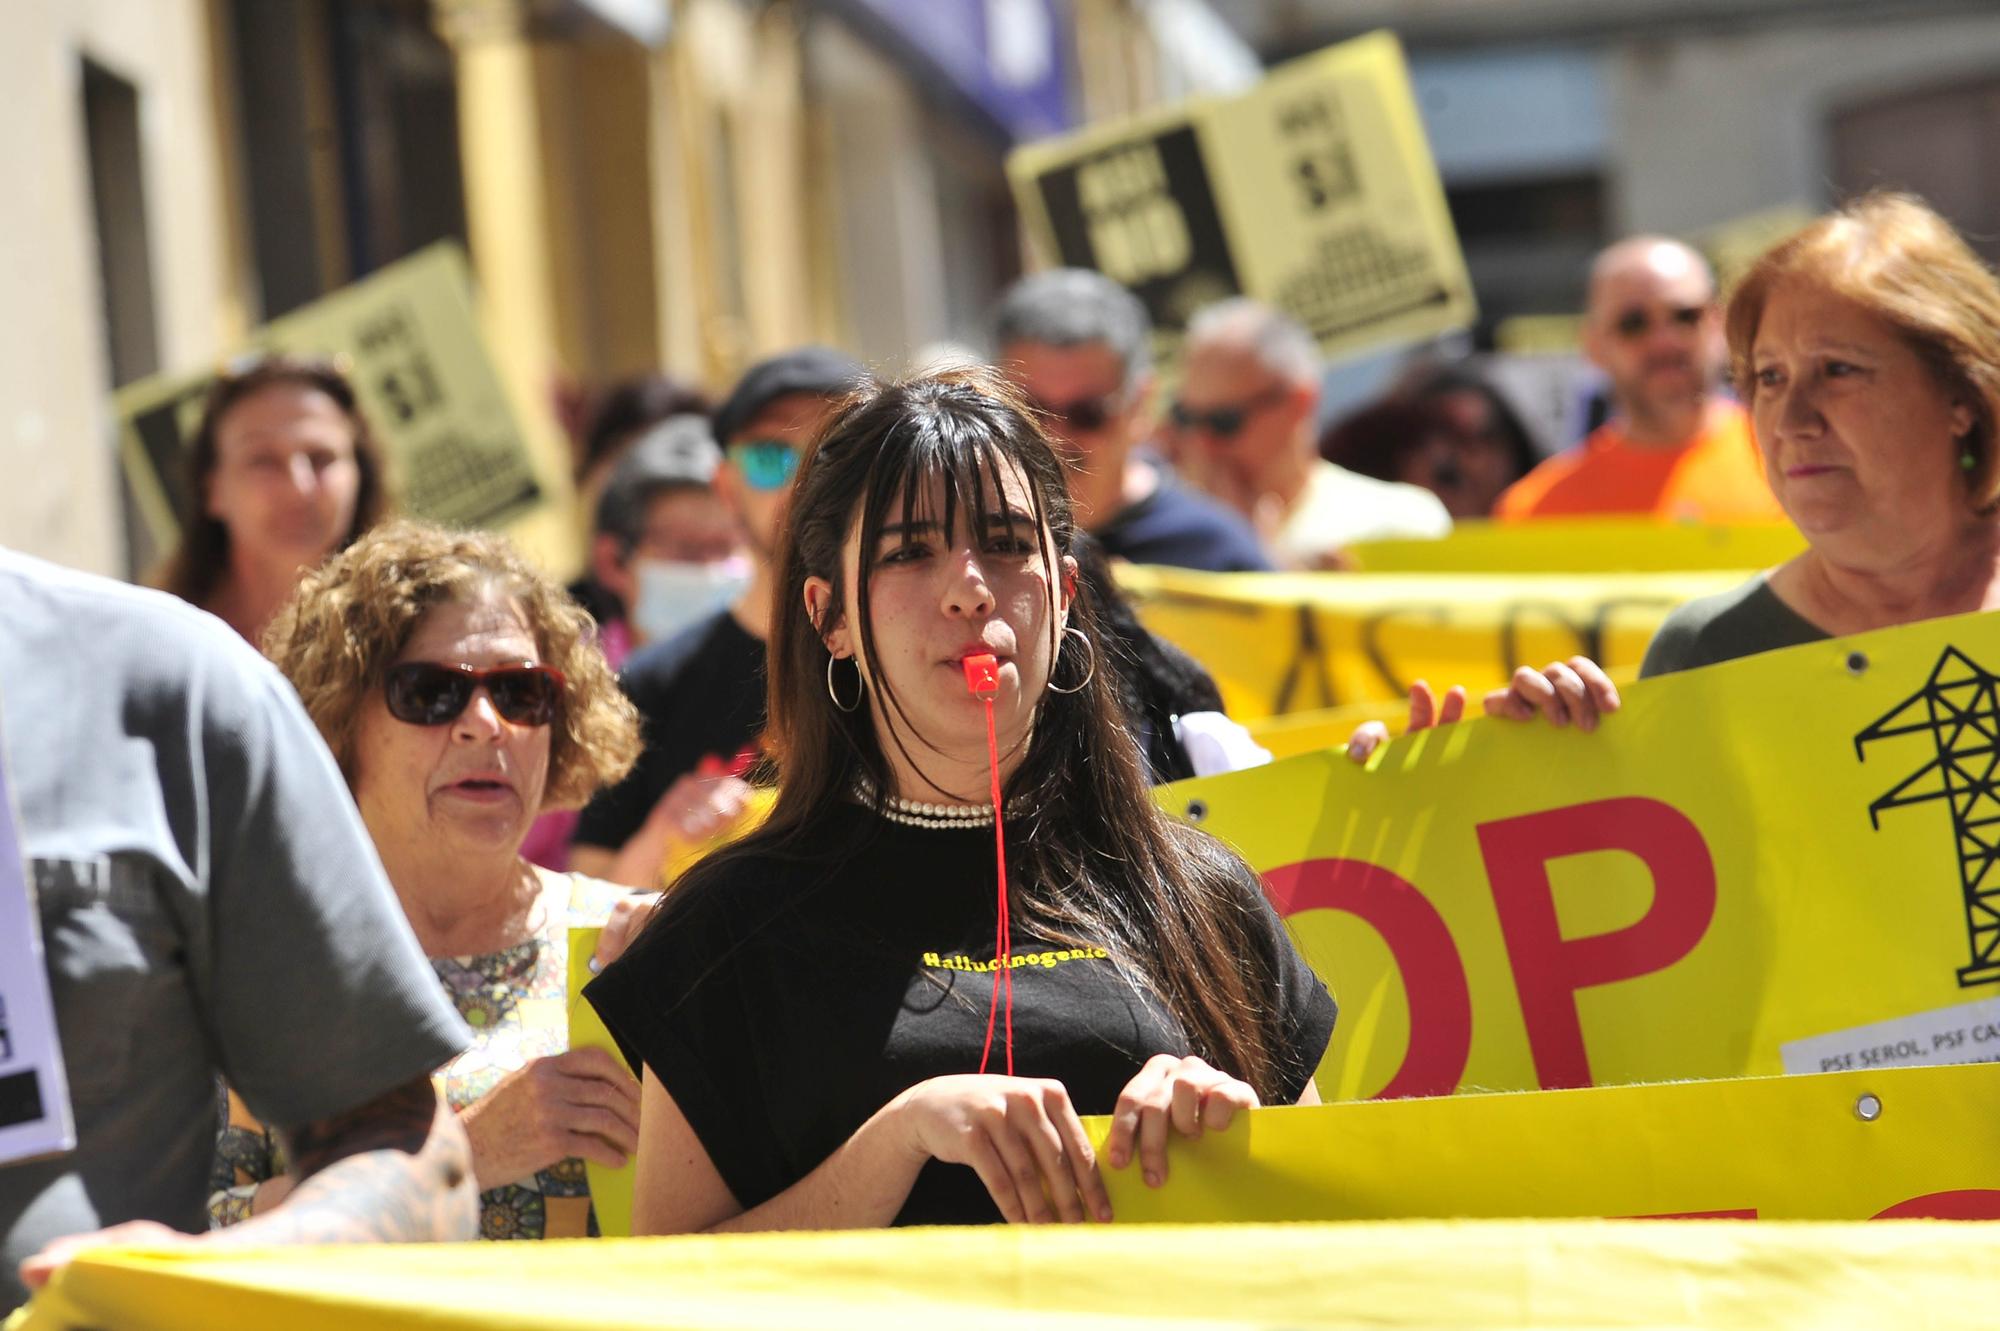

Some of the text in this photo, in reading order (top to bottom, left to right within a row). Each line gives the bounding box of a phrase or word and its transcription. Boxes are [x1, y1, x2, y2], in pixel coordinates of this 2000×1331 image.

[922, 945, 1109, 972] Hallucinogenic
[1819, 1053, 1853, 1072] PSF
[1932, 1028, 1966, 1051] PSF
[1972, 1021, 2000, 1043] CA
